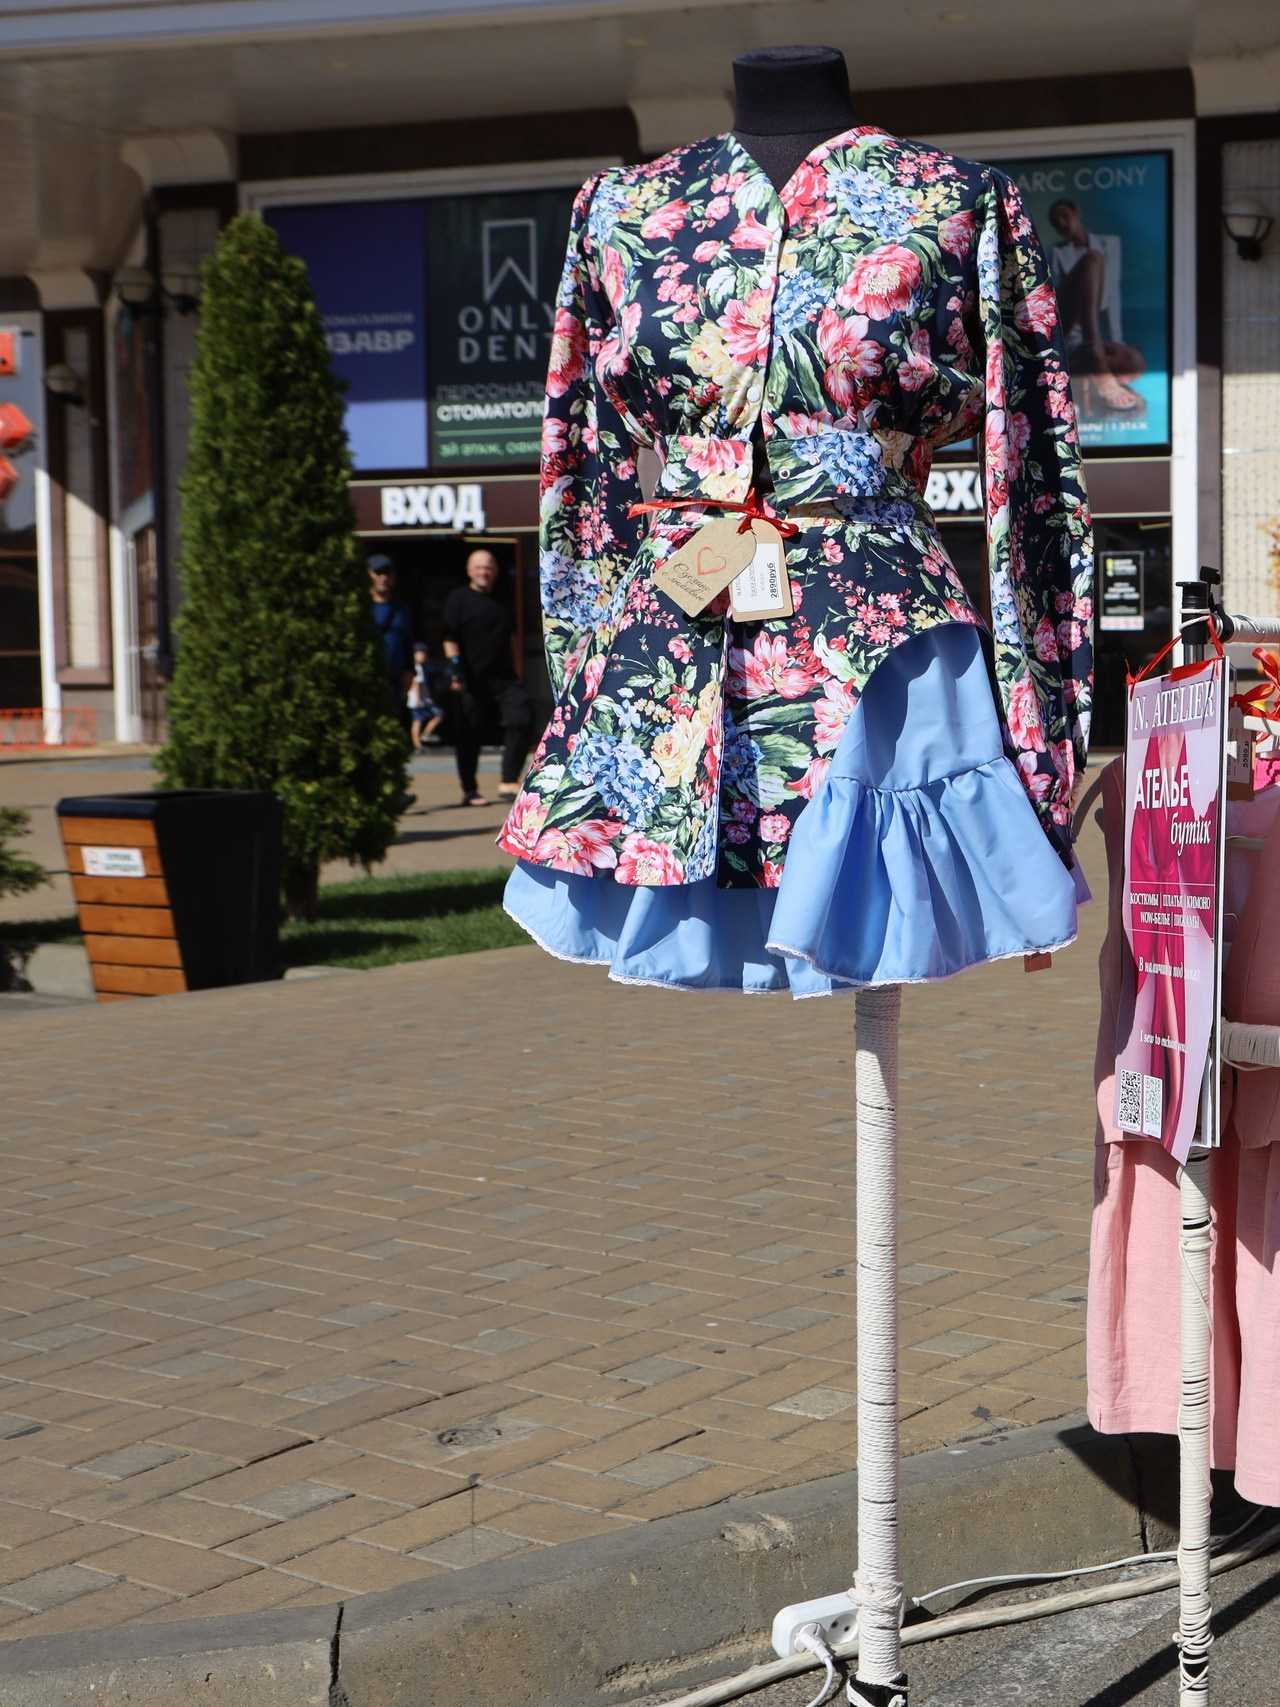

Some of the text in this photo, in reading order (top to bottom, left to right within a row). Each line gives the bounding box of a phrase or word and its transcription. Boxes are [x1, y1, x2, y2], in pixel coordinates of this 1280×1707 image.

[1073, 165, 1149, 191] CONY
[380, 483, 486, 532] ВХОД
[767, 562, 779, 599] 2890руб
[1133, 679, 1216, 732] N. ATELIER
[1133, 764, 1189, 810] АТЕЛЬЕ
[1170, 811, 1211, 856] бутик
[1129, 892, 1159, 906] КОСТЮМЫ
[1140, 911, 1170, 926] WOW-БЕЛЬЕ
[1138, 956, 1144, 972] В
